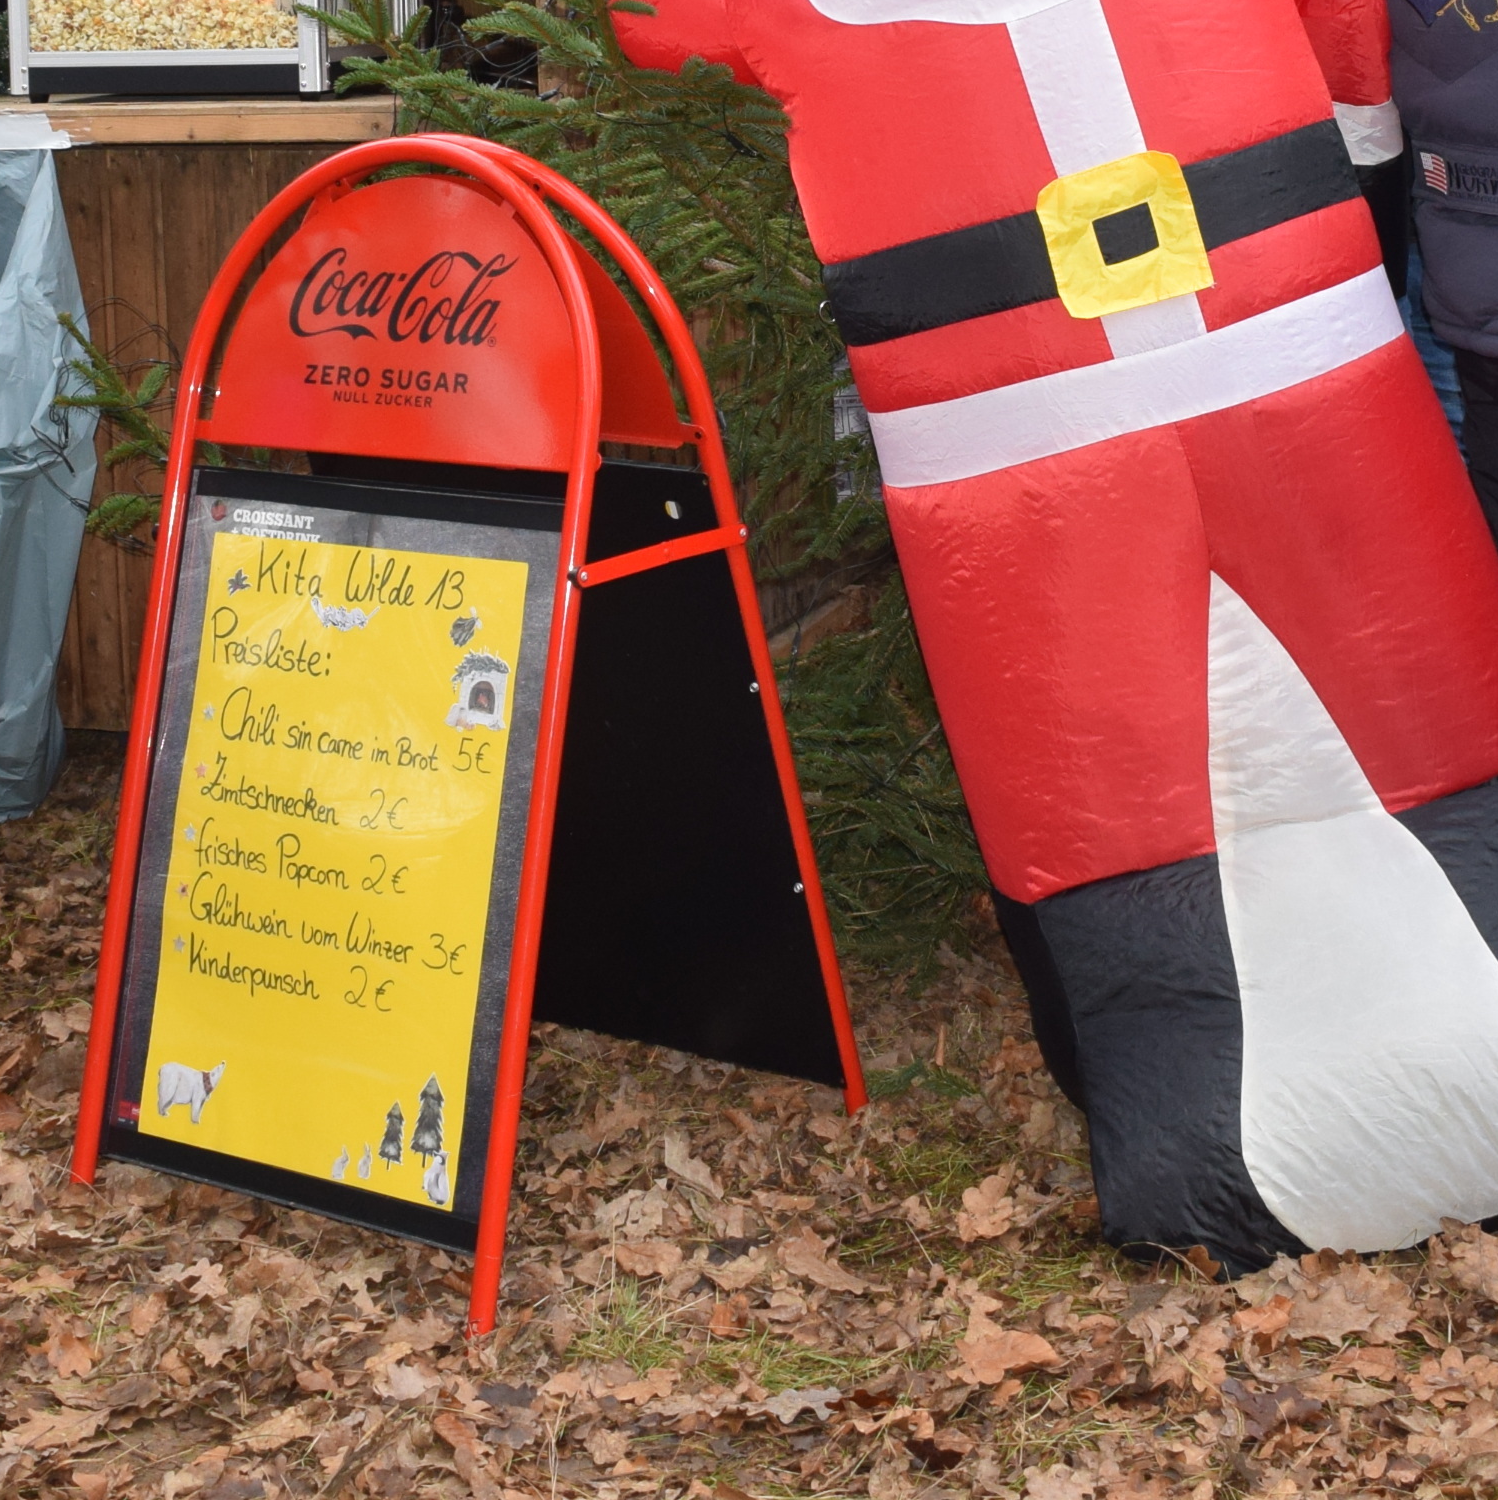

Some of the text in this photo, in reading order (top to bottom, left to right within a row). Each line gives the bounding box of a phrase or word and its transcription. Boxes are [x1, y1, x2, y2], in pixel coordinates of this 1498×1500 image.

[304, 364, 470, 395] ZERO SUGAR
[333, 390, 433, 409] NULL ZUCKER
[232, 508, 315, 530] CROISSANT
[254, 540, 466, 610] Kita Wilde 13
[210, 605, 332, 677] Preisliste:
[219, 685, 281, 744] Chili
[286, 721, 313, 751] sin
[369, 735, 391, 767] im
[395, 736, 440, 772] Brot
[199, 751, 340, 827] Zimtschnecken
[193, 817, 268, 875] frisches
[276, 832, 350, 891] Popcorn
[189, 871, 293, 939] Glühwein
[301, 919, 340, 951] vom
[345, 910, 415, 965] Winzer
[188, 931, 320, 1000] Kinderpunsch
